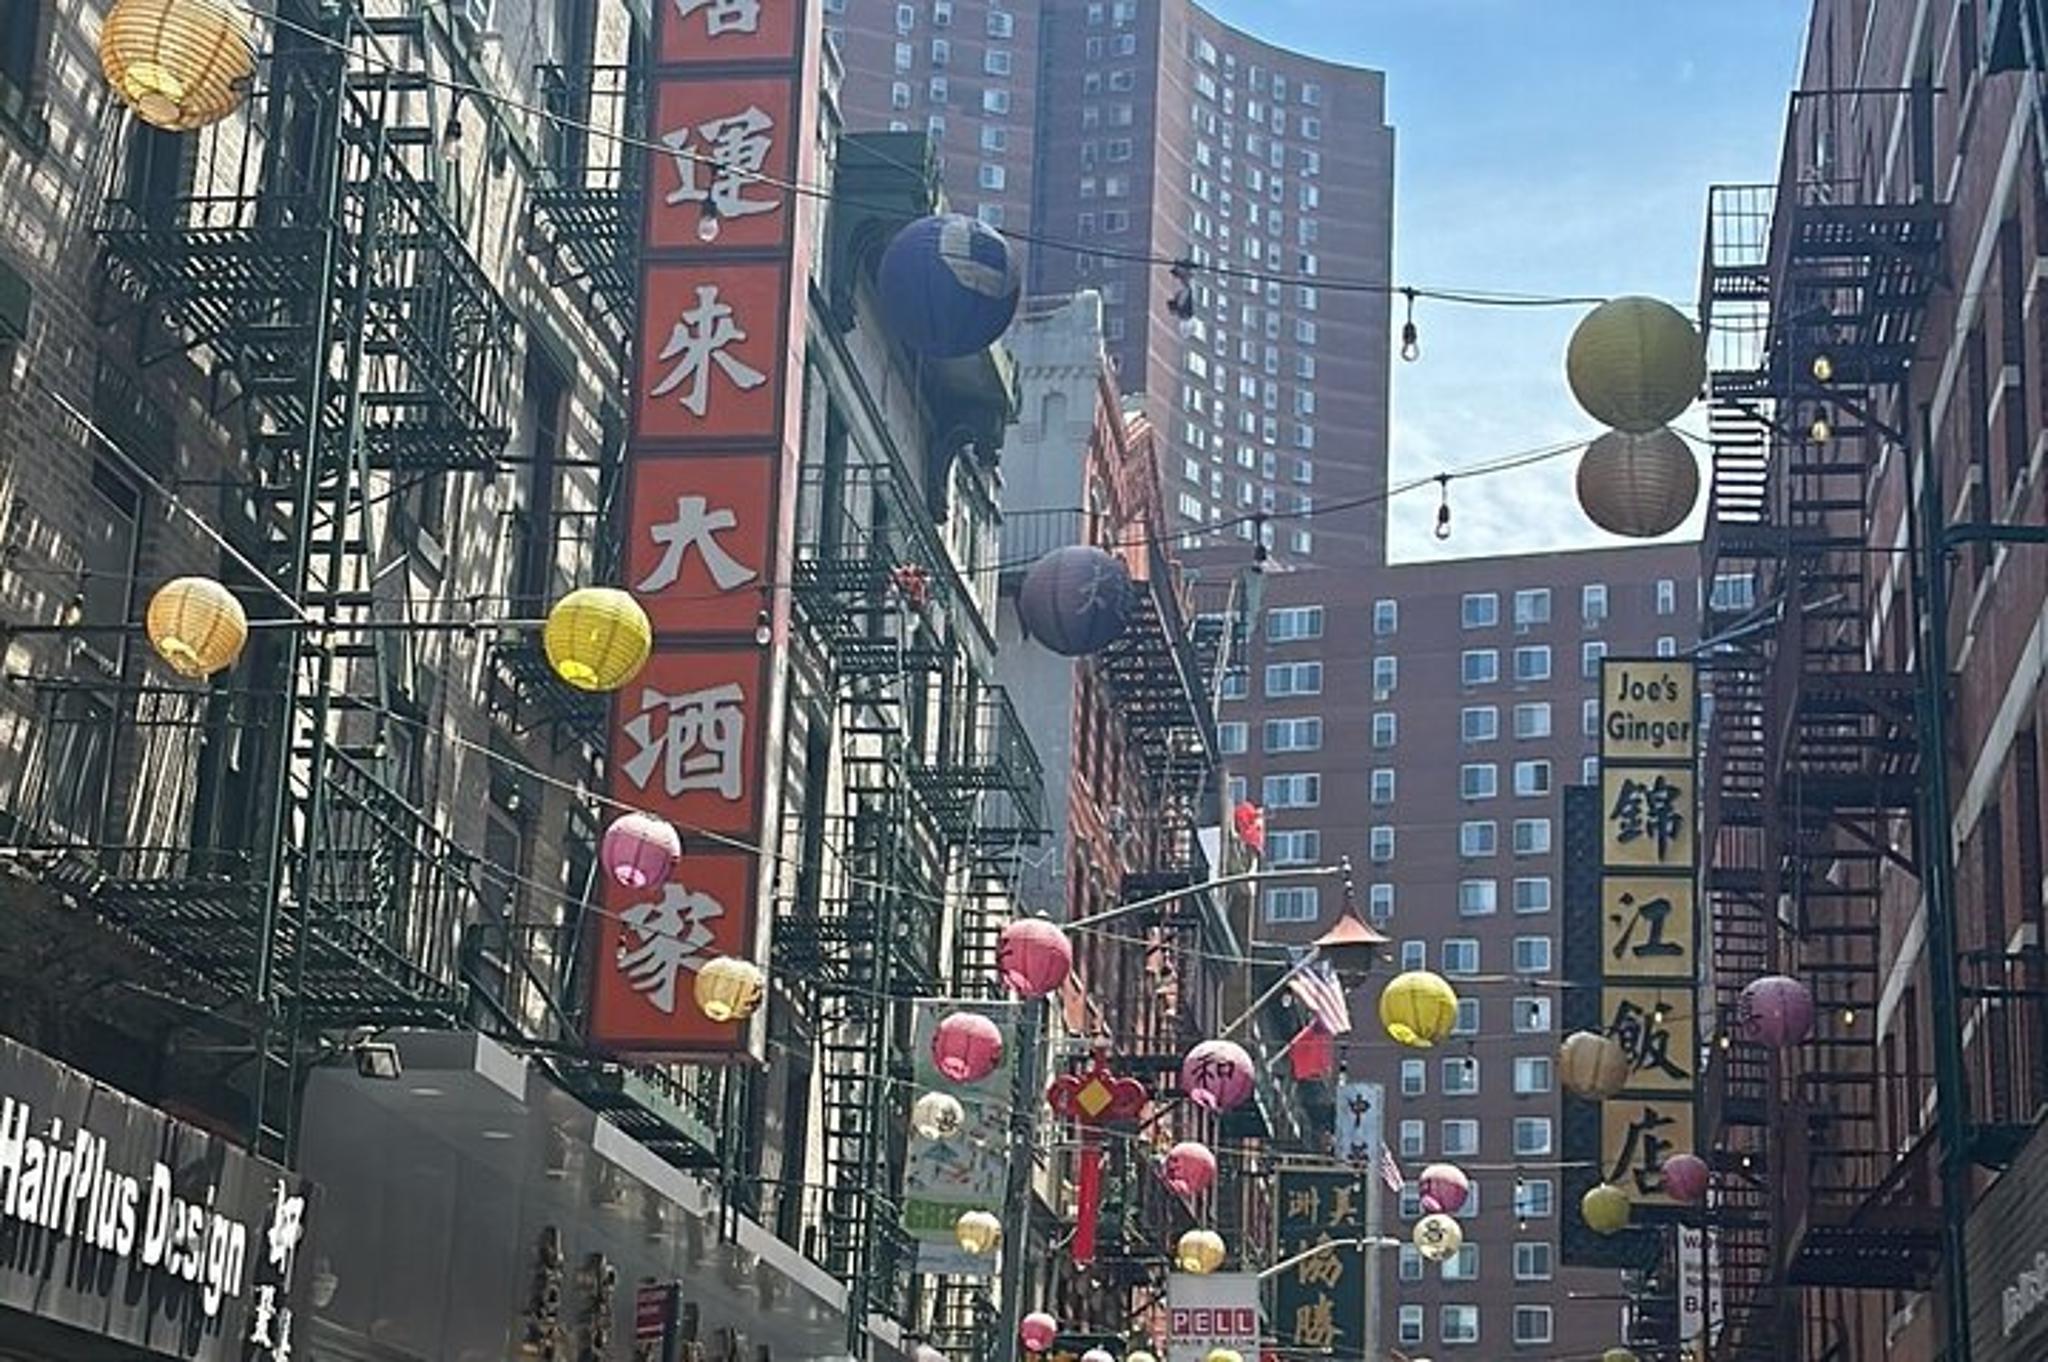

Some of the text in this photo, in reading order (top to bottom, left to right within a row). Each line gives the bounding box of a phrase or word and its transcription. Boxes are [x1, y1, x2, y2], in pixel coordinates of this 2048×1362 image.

[1618, 671, 1679, 702] Joe's
[1606, 711, 1691, 748] Ginger
[1603, 774, 1690, 1195] 錦江飯店
[1192, 1052, 1235, 1092] 和
[142, 1161, 246, 1317] Design
[1174, 1313, 1251, 1331] PELL
